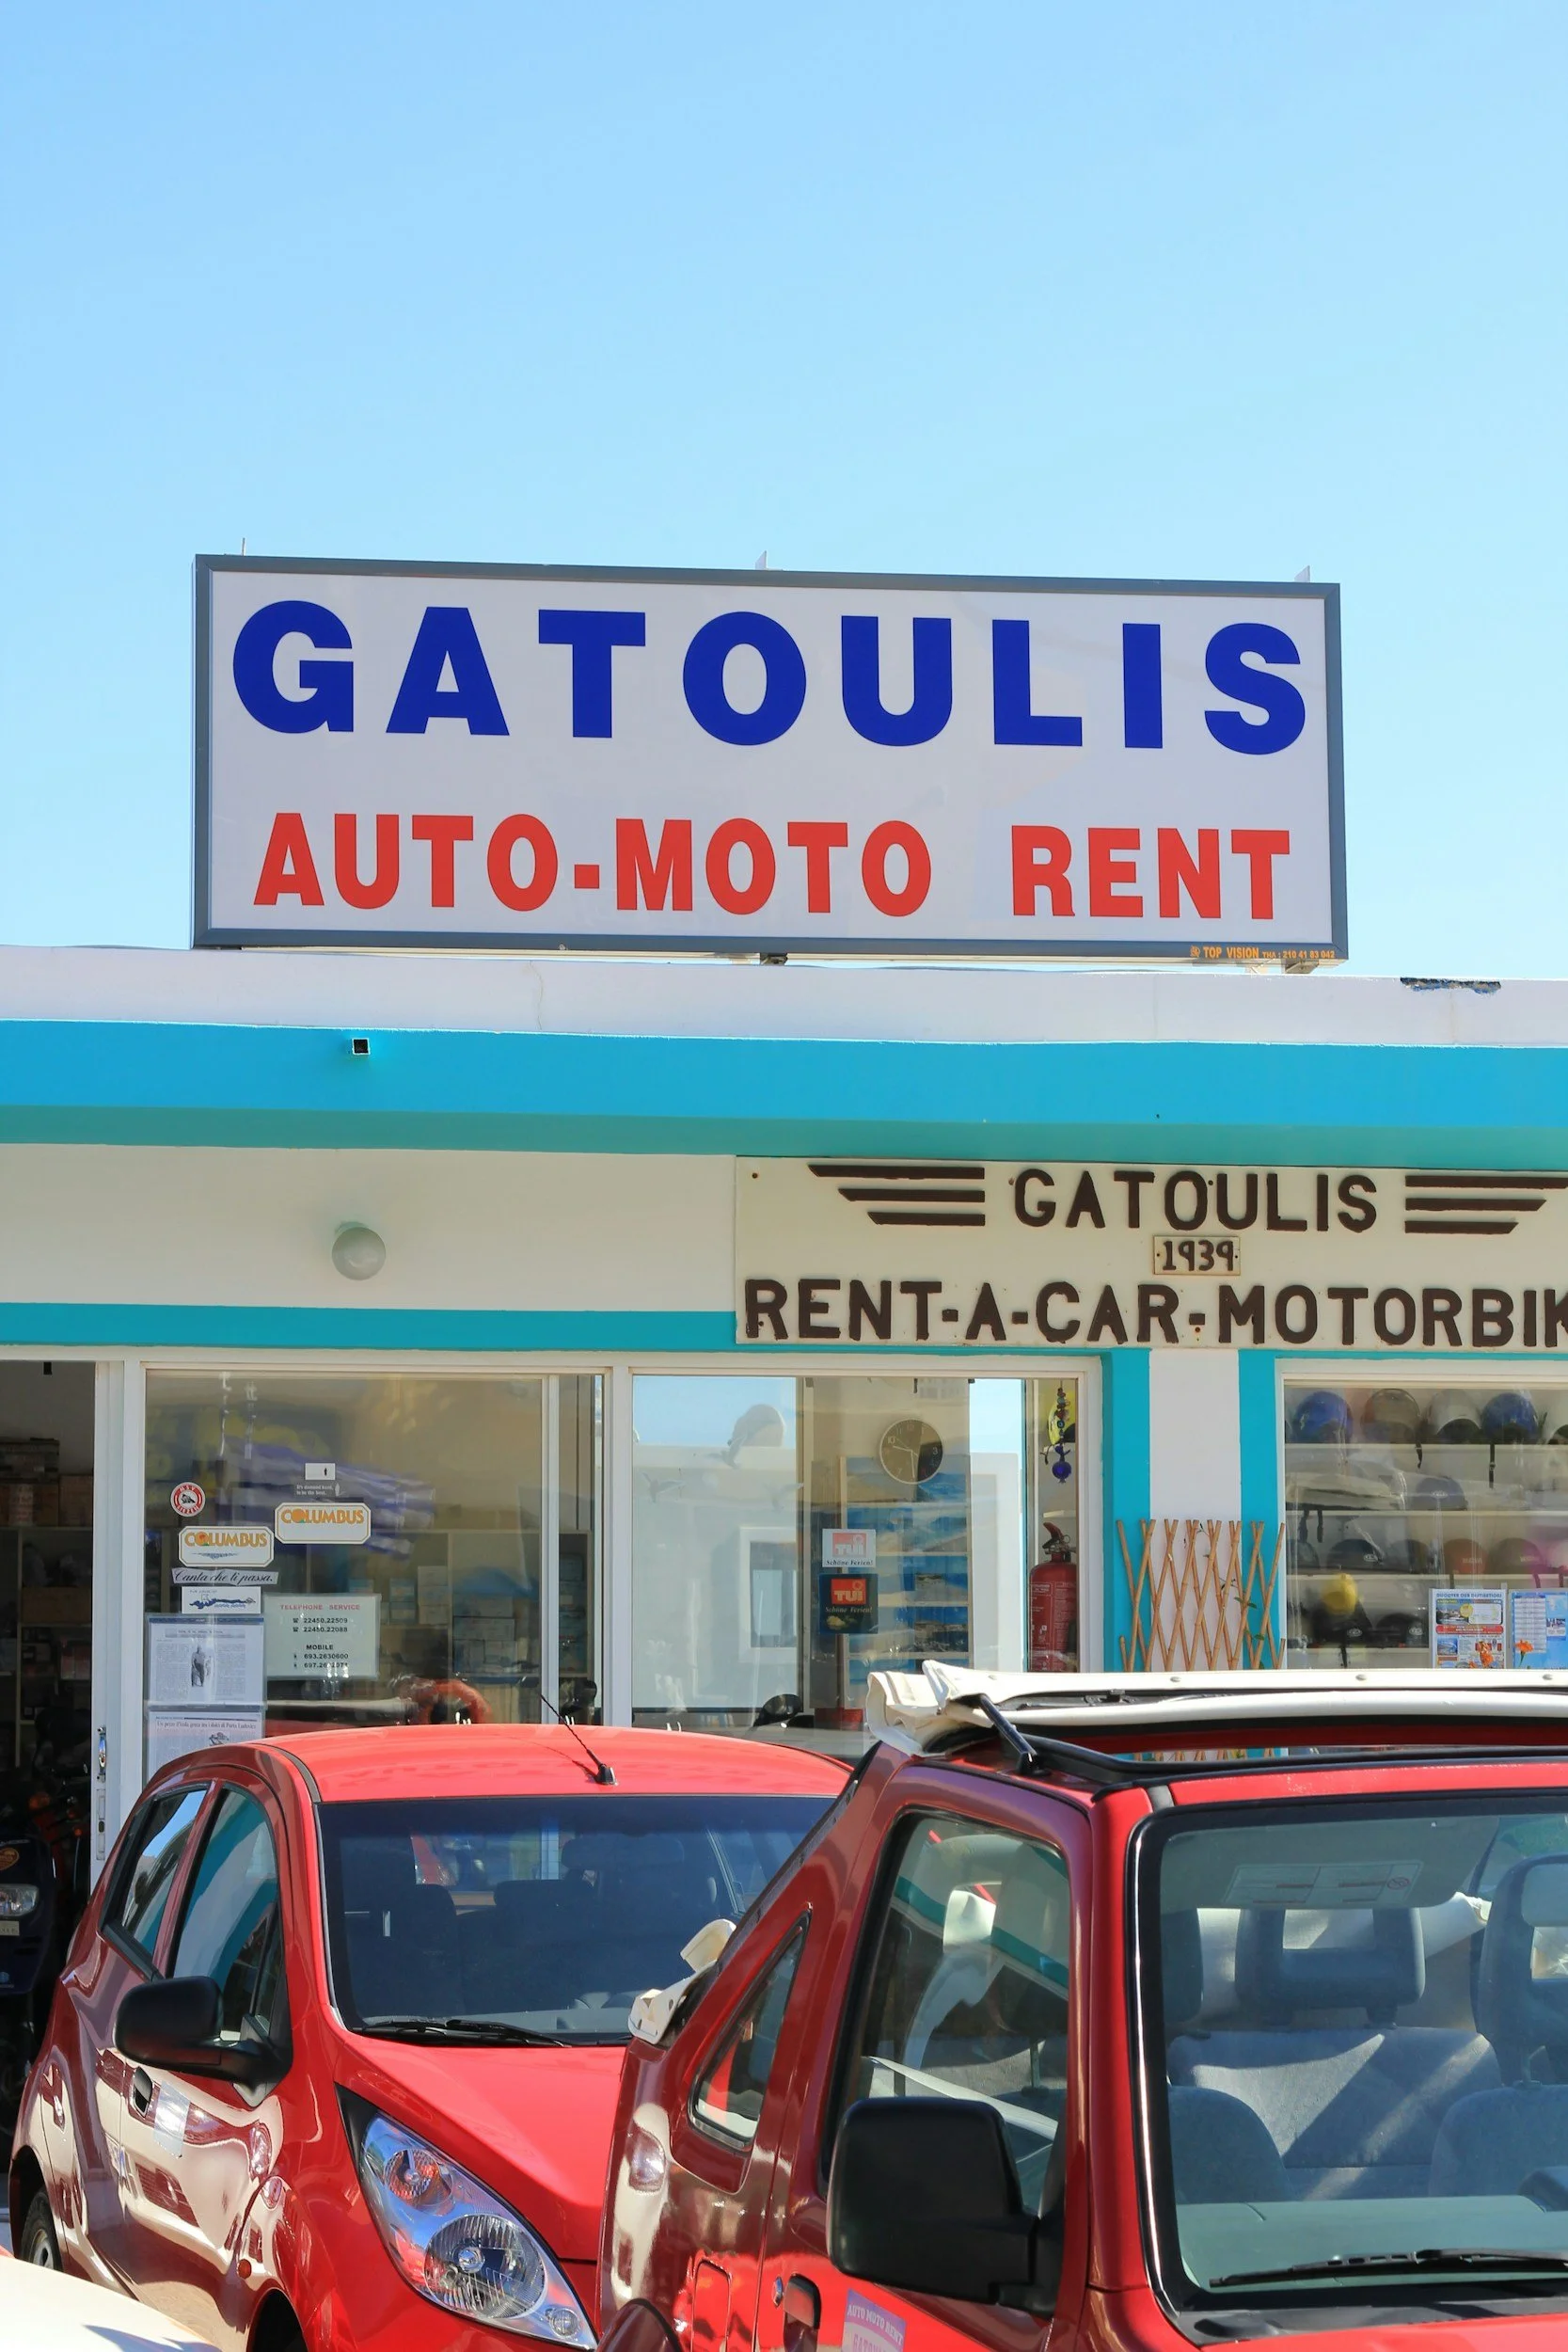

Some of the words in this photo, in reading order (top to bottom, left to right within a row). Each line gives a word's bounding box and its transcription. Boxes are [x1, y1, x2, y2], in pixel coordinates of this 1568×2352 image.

[232, 600, 1306, 755] GATOULIS
[253, 813, 931, 916] AUTO-MOTO
[1011, 825, 1291, 919] RENT
[1203, 946, 1222, 958] TOP
[1227, 947, 1259, 959] VISION
[1298, 950, 1307, 959] 41
[1014, 1168, 1377, 1232] GATOULIS
[1163, 1240, 1234, 1272] 1939
[281, 1508, 365, 1524] COLUMBUS
[184, 1531, 268, 1548] COLUMBUS
[175, 1570, 207, 1581] Canta
[833, 1581, 863, 1602] TUI
[847, 2304, 865, 2319] AUTO
[865, 2310, 885, 2328] MOTO
